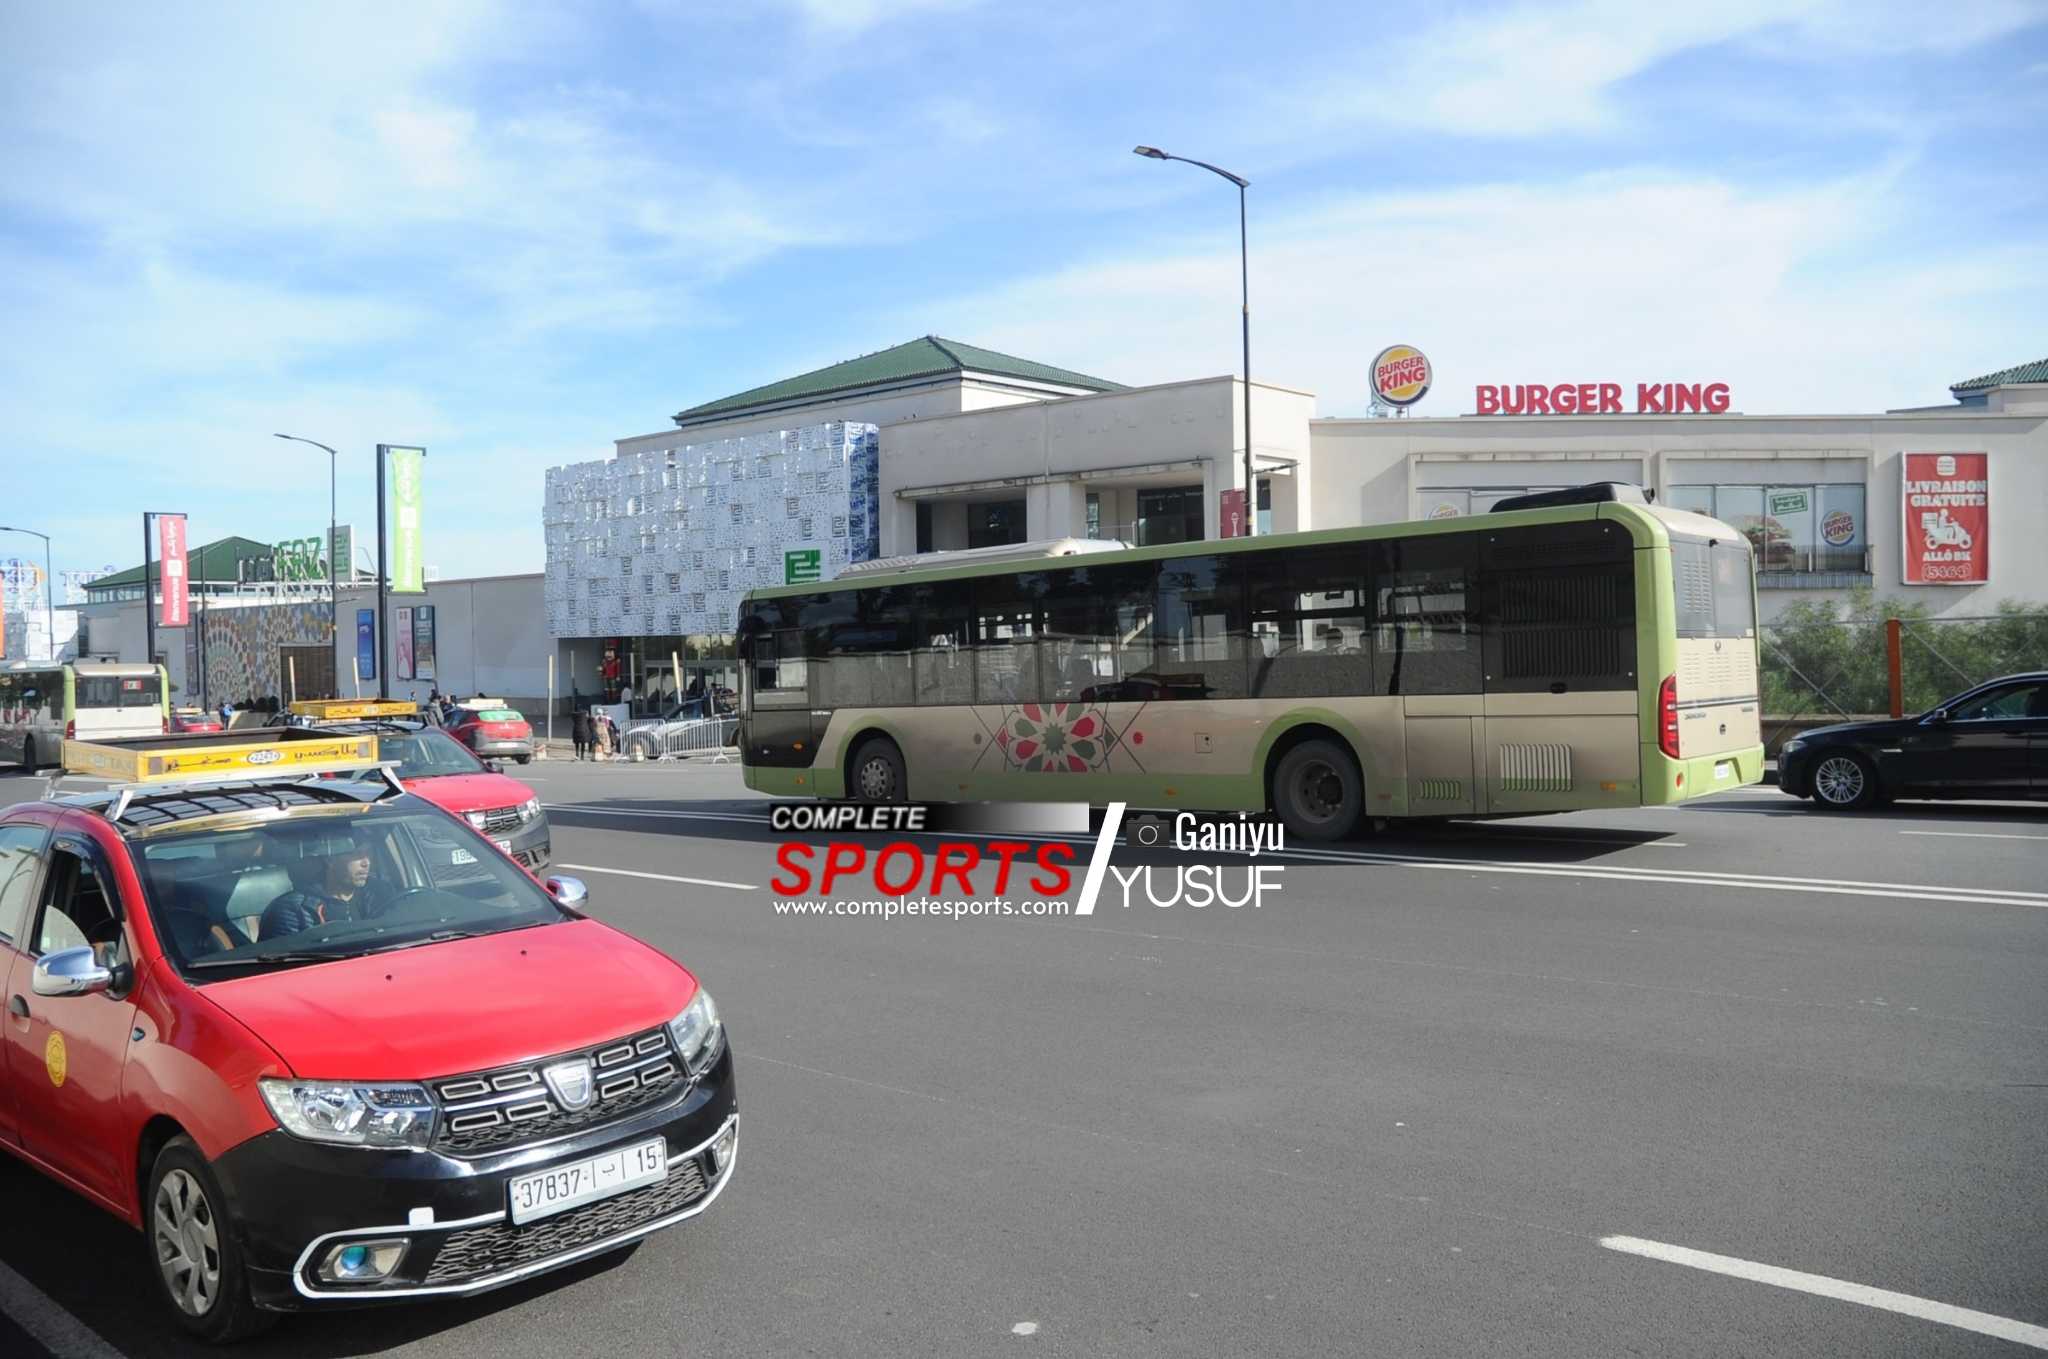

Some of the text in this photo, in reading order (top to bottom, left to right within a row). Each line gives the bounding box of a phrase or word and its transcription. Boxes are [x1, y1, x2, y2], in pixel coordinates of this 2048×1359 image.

[1377, 356, 1424, 377] BURGER
[1380, 367, 1425, 393] KING
[1475, 383, 1730, 415] BURGER KING
[1905, 480, 1986, 493] LIVRAISON
[1911, 494, 1986, 507] GRATUITE
[1823, 515, 1852, 529] BURGER
[1824, 522, 1854, 539] KING
[520, 1169, 581, 1208] 37837
[637, 1145, 657, 1172] 15
